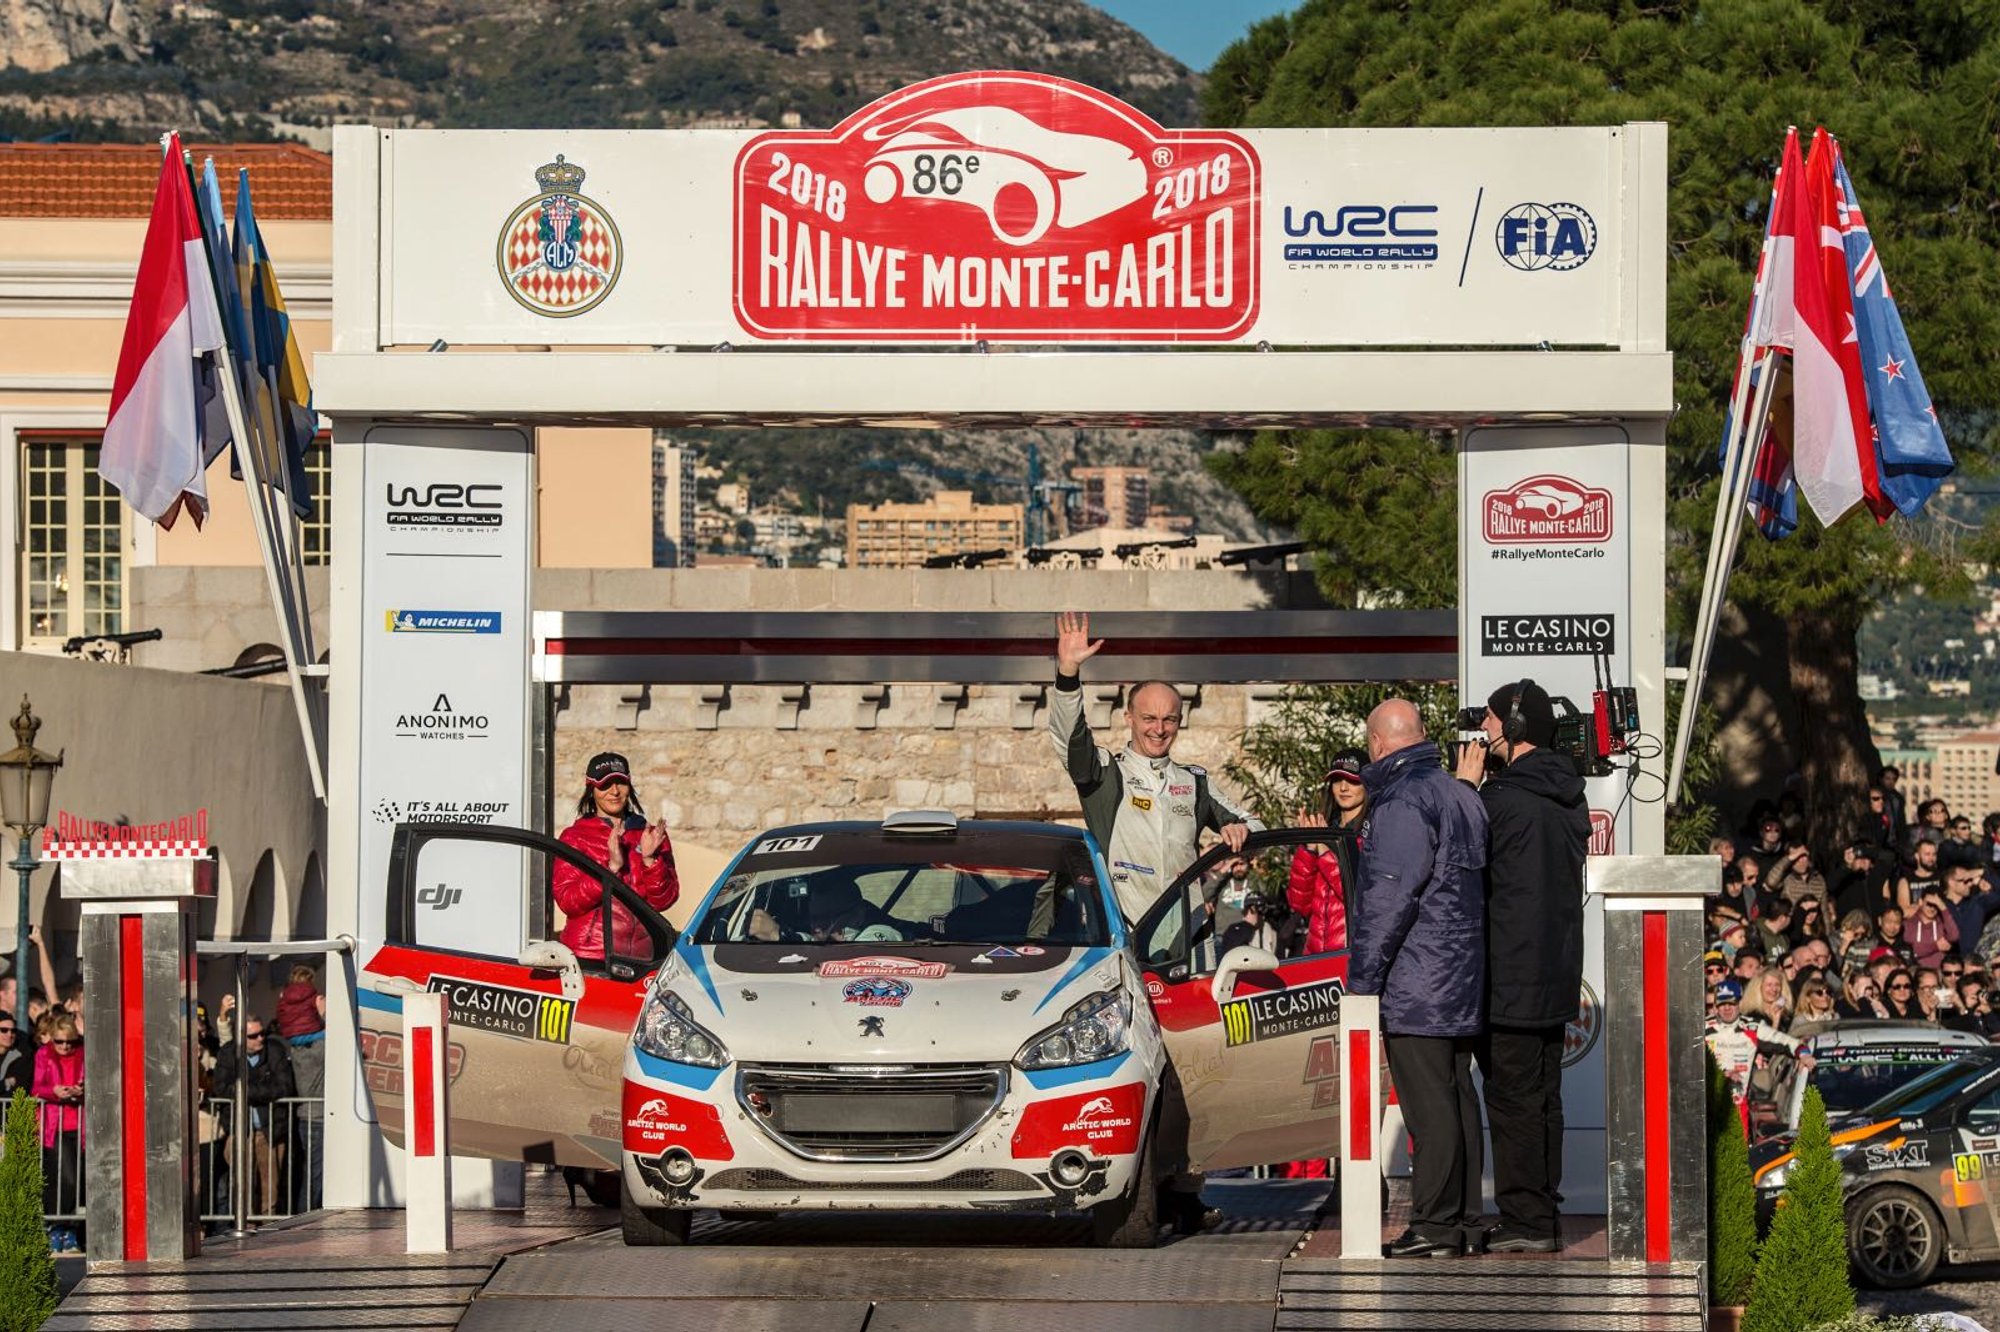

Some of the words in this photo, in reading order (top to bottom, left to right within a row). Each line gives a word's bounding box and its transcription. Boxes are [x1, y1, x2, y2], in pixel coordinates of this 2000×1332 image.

[768, 151, 847, 224] 2018
[1151, 152, 1232, 220] 2018
[1284, 205, 1439, 237] WRC
[760, 202, 907, 309] RALLYE
[921, 206, 1235, 309] MONTE-CARLO
[1288, 248, 1312, 257] FIA
[1316, 248, 1374, 257] WORLD
[1378, 248, 1434, 257] RALLY
[387, 483, 503, 508] WRC
[1492, 499, 1513, 516] 2018
[1583, 497, 1605, 515] 2018
[389, 514, 409, 522] FIA
[410, 515, 454, 523] WORLD
[457, 516, 500, 524] RALLY
[1491, 510, 1527, 535] RALLYE
[1529, 510, 1605, 535] MONTE-CARLO
[1491, 547, 1605, 562] #RallyeMonteCarlo
[418, 617, 492, 628] MICHELIN
[1485, 620, 1509, 639] LE
[1514, 618, 1612, 638] CASINO
[396, 715, 489, 729] ANONIMO
[420, 732, 465, 740] WATCHES
[407, 801, 431, 813] IT'S
[434, 802, 459, 813] ALL
[463, 802, 510, 813] ABOUT
[407, 813, 493, 824] MOTORSPORT
[766, 836, 815, 852] 101
[1148, 984, 1161, 993] KIA
[453, 986, 533, 1018] CASINO
[1255, 1000, 1274, 1020] LE
[1276, 986, 1340, 1016] CASINO
[541, 998, 571, 1042] 101
[1223, 1002, 1250, 1045] 101
[627, 1119, 654, 1129] ARCTIC
[656, 1121, 687, 1132] WORLD
[1062, 1120, 1100, 1131] ARCTIC
[1101, 1118, 1131, 1127] WORLD
[642, 1131, 665, 1140] CLUB
[1087, 1129, 1113, 1139] CLUB
[1956, 1154, 1981, 1181] 99
